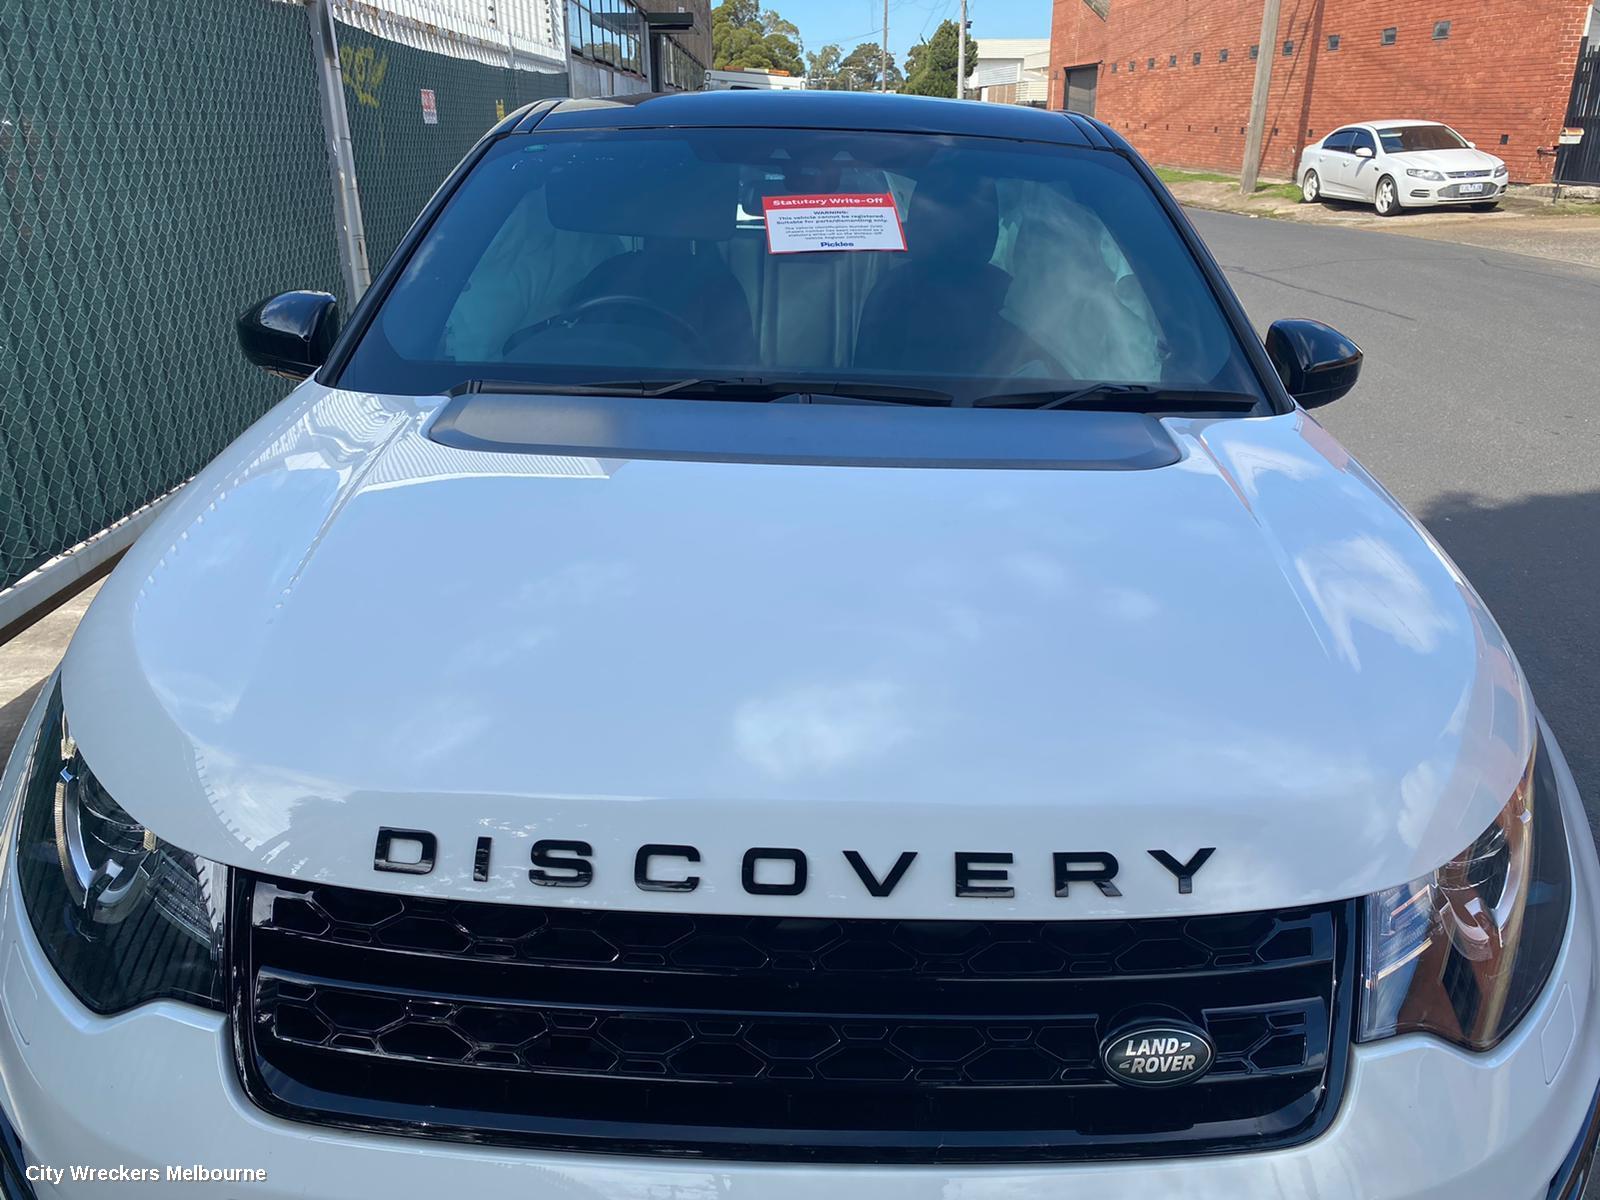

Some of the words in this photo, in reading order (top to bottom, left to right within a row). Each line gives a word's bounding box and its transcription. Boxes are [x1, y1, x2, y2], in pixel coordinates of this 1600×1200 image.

[374, 826, 1217, 898] DISCOVERY
[1125, 1037, 1179, 1056] LAND
[1130, 1055, 1196, 1074] ROVER
